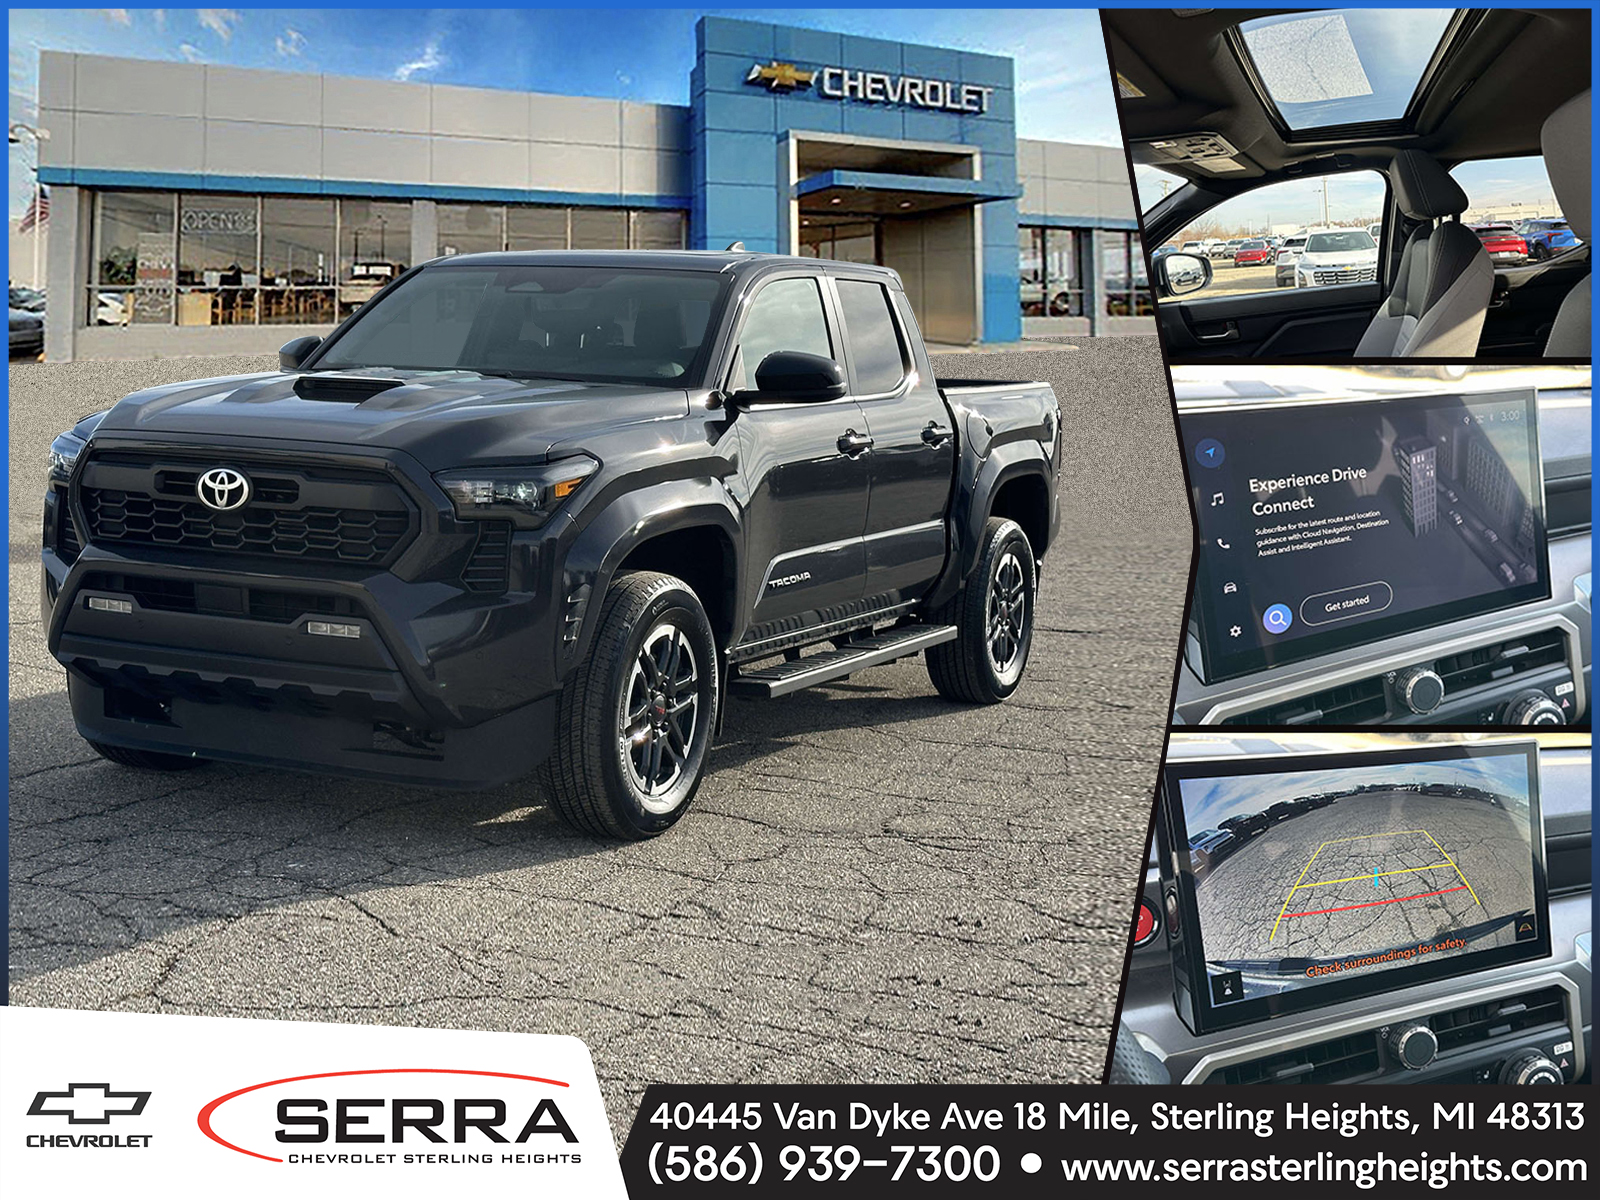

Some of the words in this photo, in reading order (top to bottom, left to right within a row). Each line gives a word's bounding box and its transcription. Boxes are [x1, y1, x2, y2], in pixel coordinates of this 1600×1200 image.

[823, 67, 993, 112] CHEVROLET
[1501, 410, 1520, 422] 3:00
[1249, 474, 1330, 493] Experience
[1332, 467, 1367, 482] Drive
[1252, 496, 1315, 516] Connect
[1255, 525, 1287, 536] Subscribe
[1288, 523, 1298, 531] for
[1298, 520, 1308, 530] the
[1309, 518, 1327, 527] latest
[1327, 515, 1343, 525] route
[1345, 513, 1356, 522] and
[1356, 510, 1380, 520] location
[1256, 535, 1287, 548] guidance
[1288, 532, 1302, 541] with
[1302, 528, 1321, 539] Cloud
[1322, 524, 1355, 536] Navigation,
[1356, 518, 1389, 530] Destination
[1258, 547, 1277, 557] Assist
[1278, 545, 1291, 553] and
[1291, 539, 1323, 551] Intelligent
[769, 571, 811, 588] TACOMA
[1325, 602, 1341, 612] Get
[1342, 595, 1370, 609] started
[1305, 963, 1342, 978] Check
[1344, 949, 1417, 970] surroundings
[1418, 944, 1434, 954] for
[1435, 938, 1468, 952] safety.
